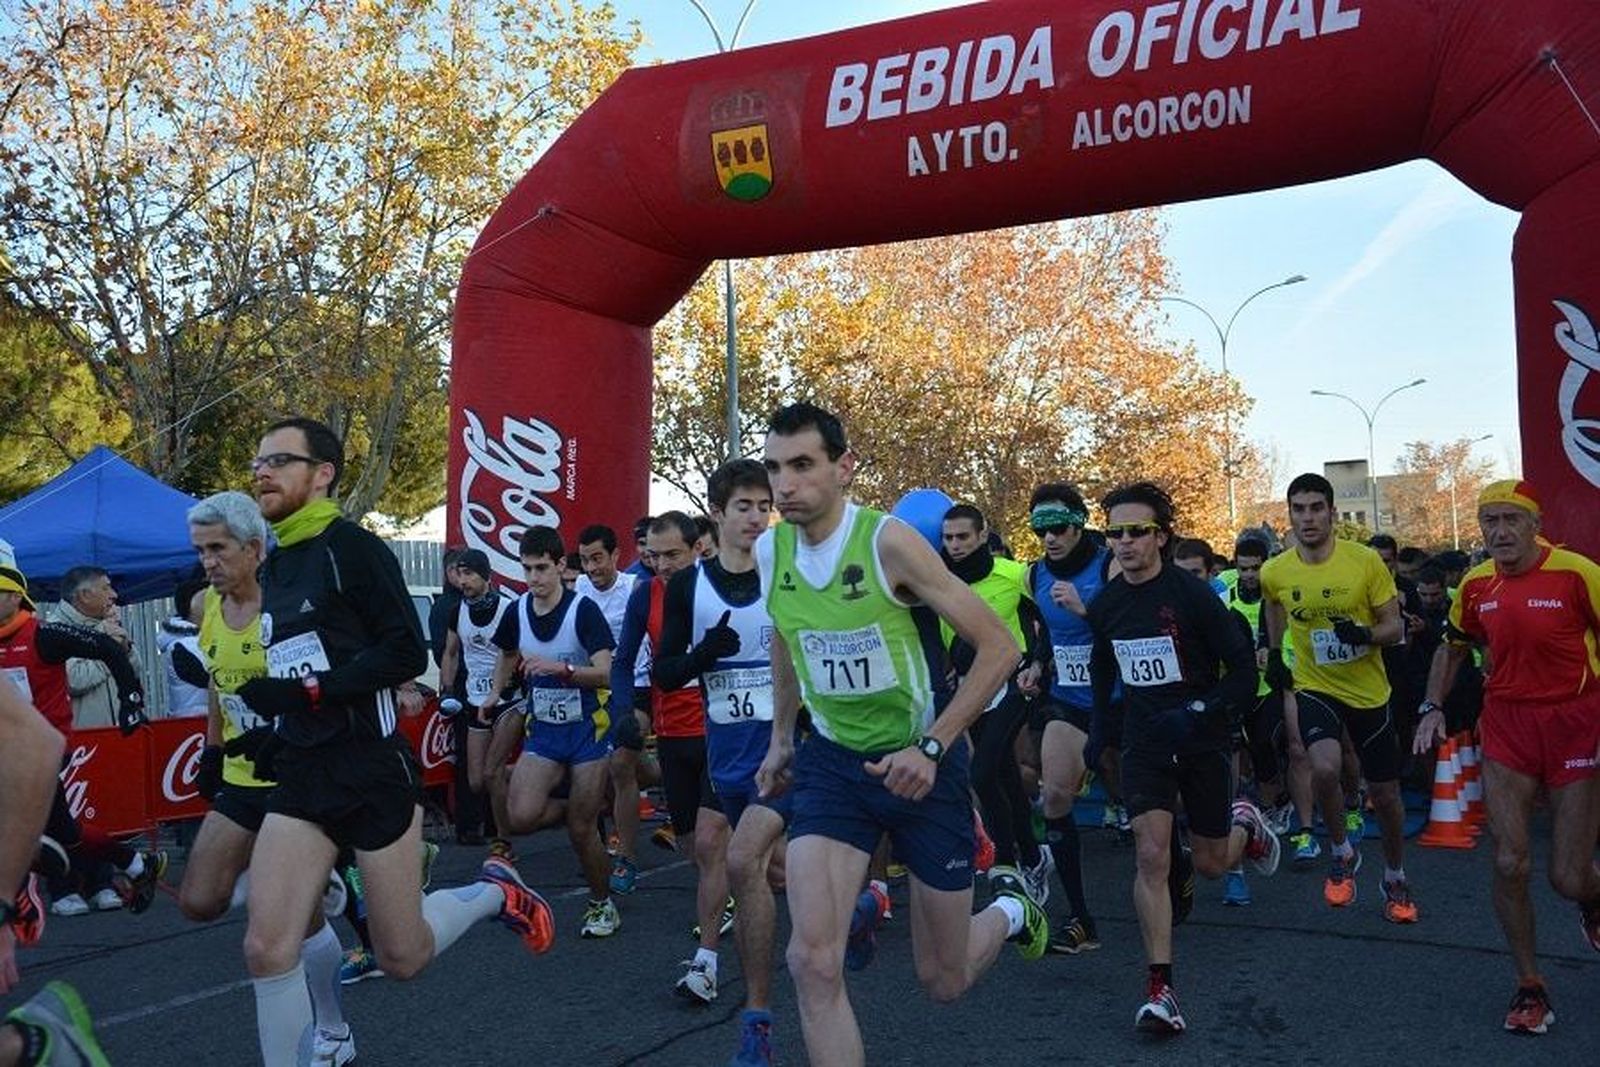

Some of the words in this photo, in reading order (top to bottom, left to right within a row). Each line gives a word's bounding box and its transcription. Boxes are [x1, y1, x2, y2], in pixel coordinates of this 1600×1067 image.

[825, 25, 1055, 128] BEBIDA
[1087, 0, 1361, 78] OFICIAL
[907, 121, 1018, 177] AYTO.
[1072, 84, 1252, 149] ALCORCON
[823, 657, 871, 689] 717
[1131, 658, 1167, 681] 630
[548, 703, 567, 721] 45
[728, 691, 754, 718] 36
